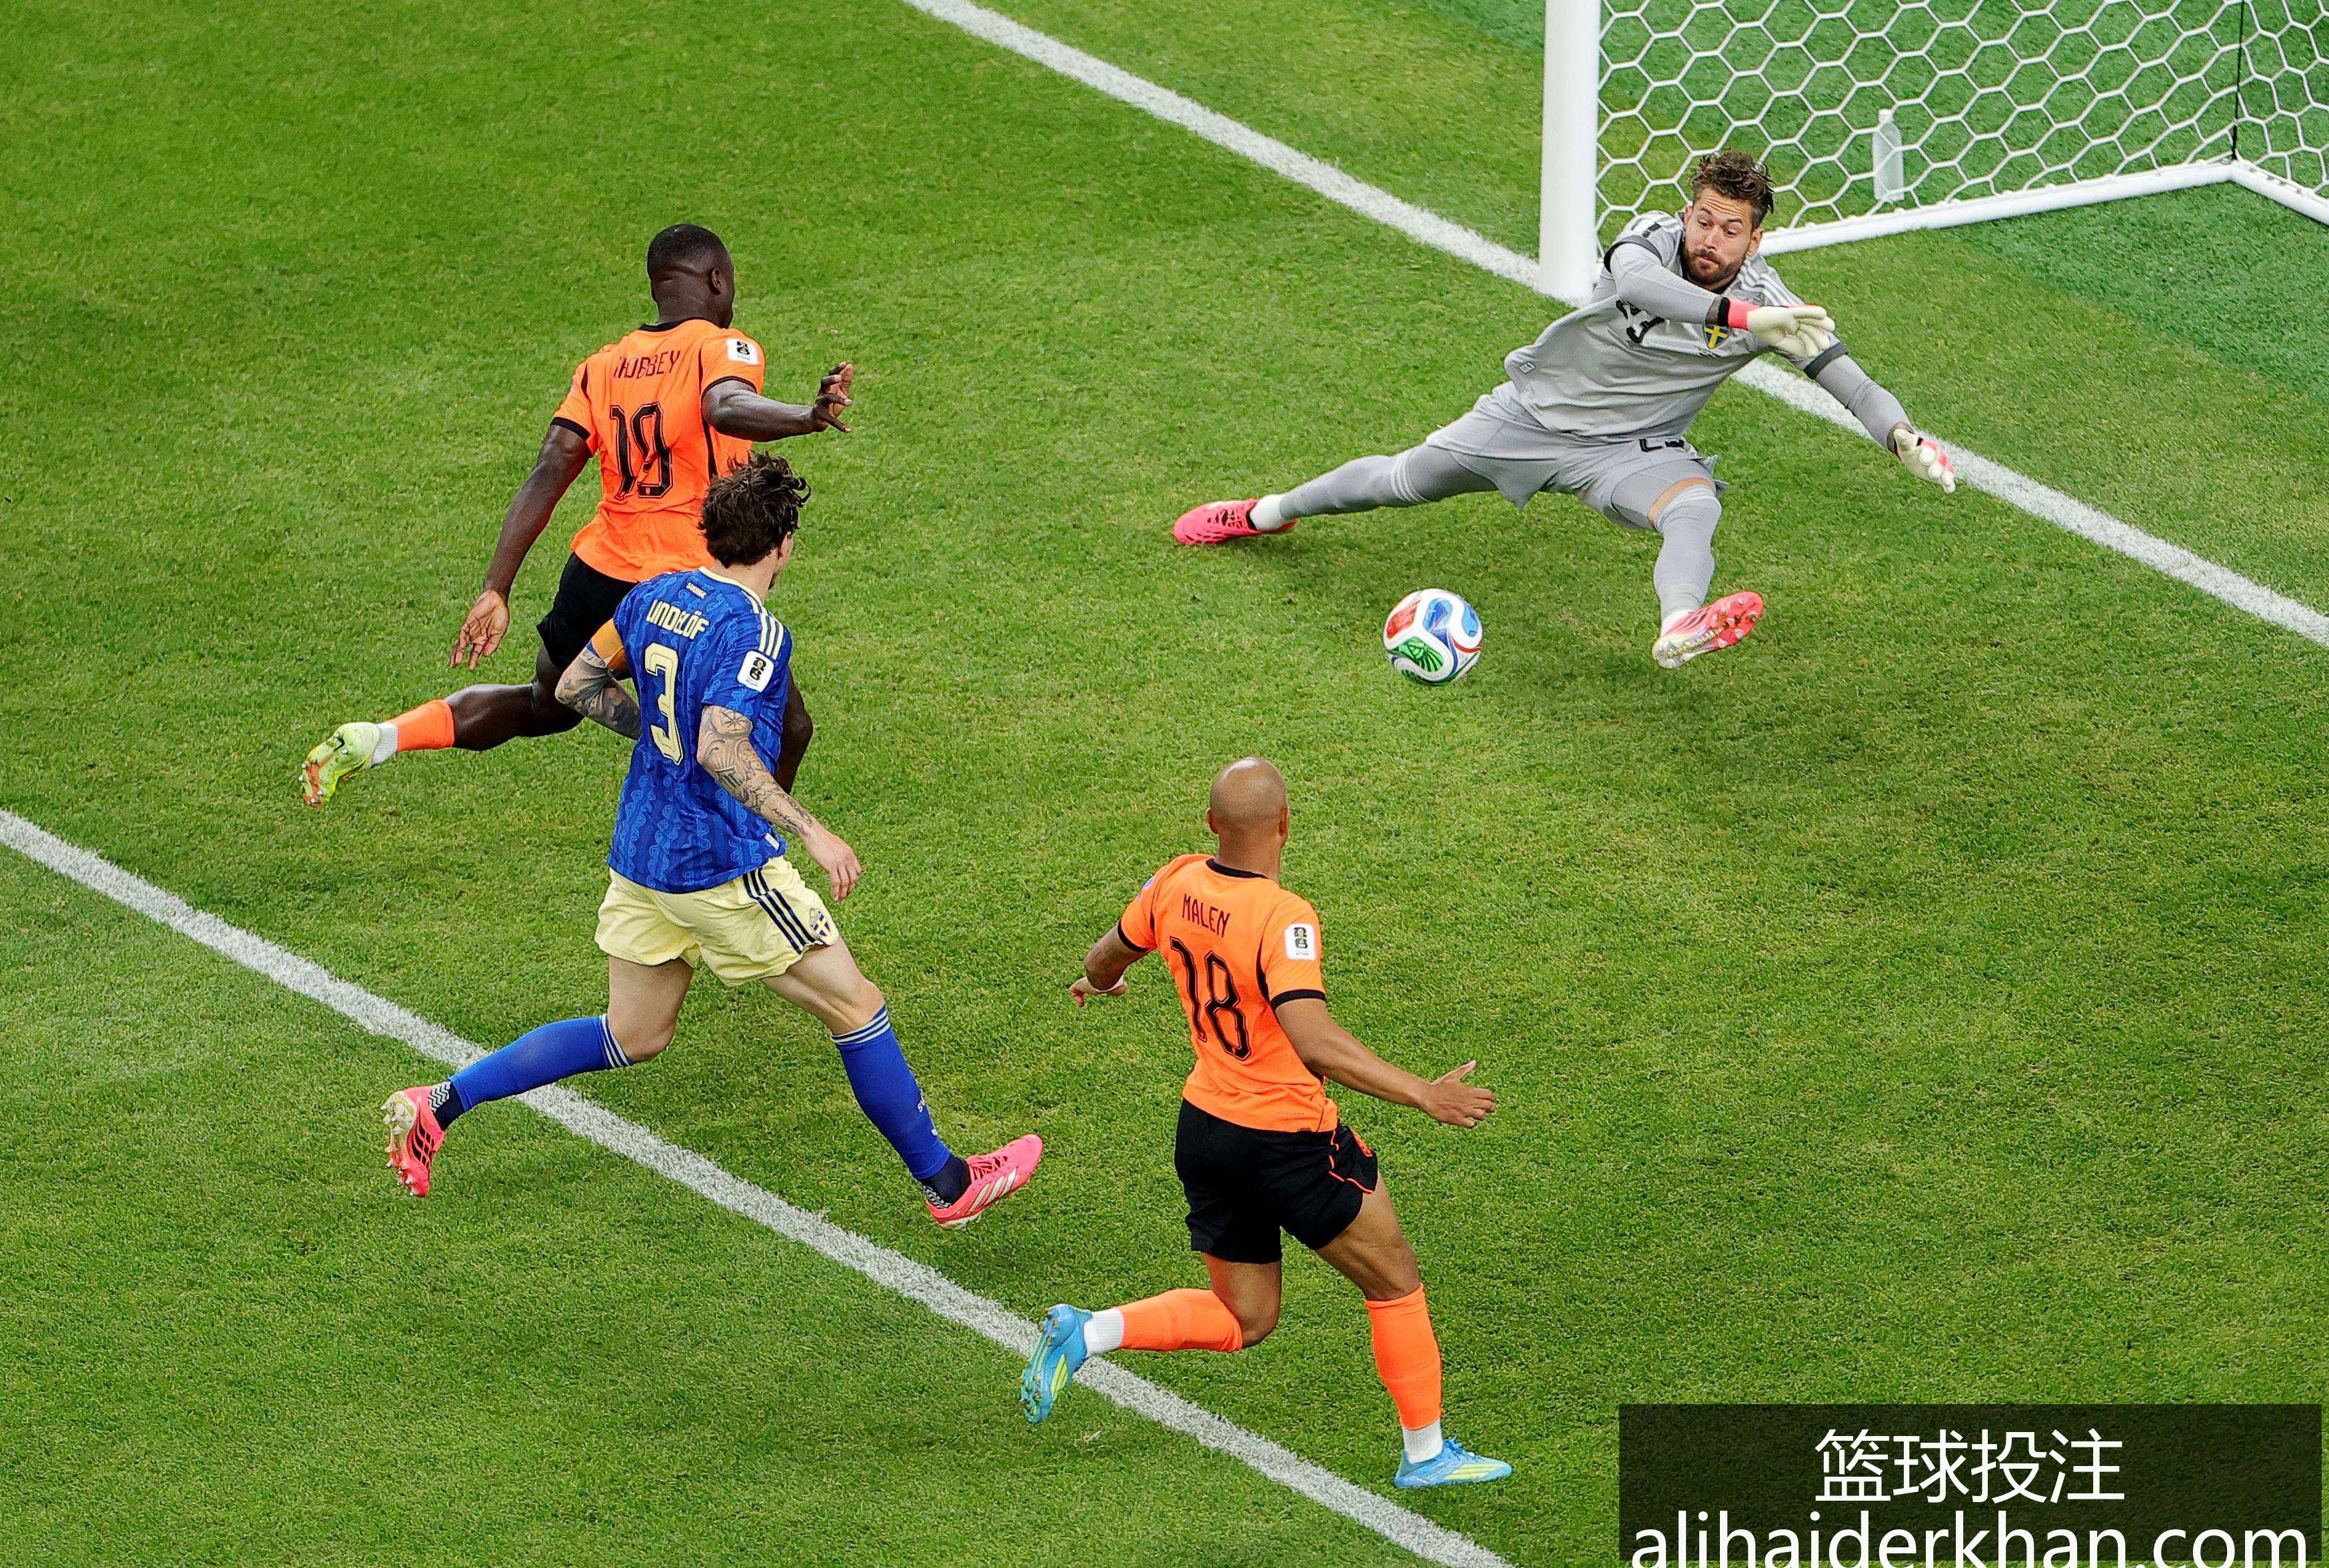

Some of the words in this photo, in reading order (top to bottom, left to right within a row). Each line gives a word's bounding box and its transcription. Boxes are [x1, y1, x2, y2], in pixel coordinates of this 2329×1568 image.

[613, 350, 681, 379] OBBEY
[610, 401, 673, 500] 19
[644, 642, 684, 766] 3
[1181, 894, 1230, 938] MALEN
[1169, 936, 1251, 1061] 18
